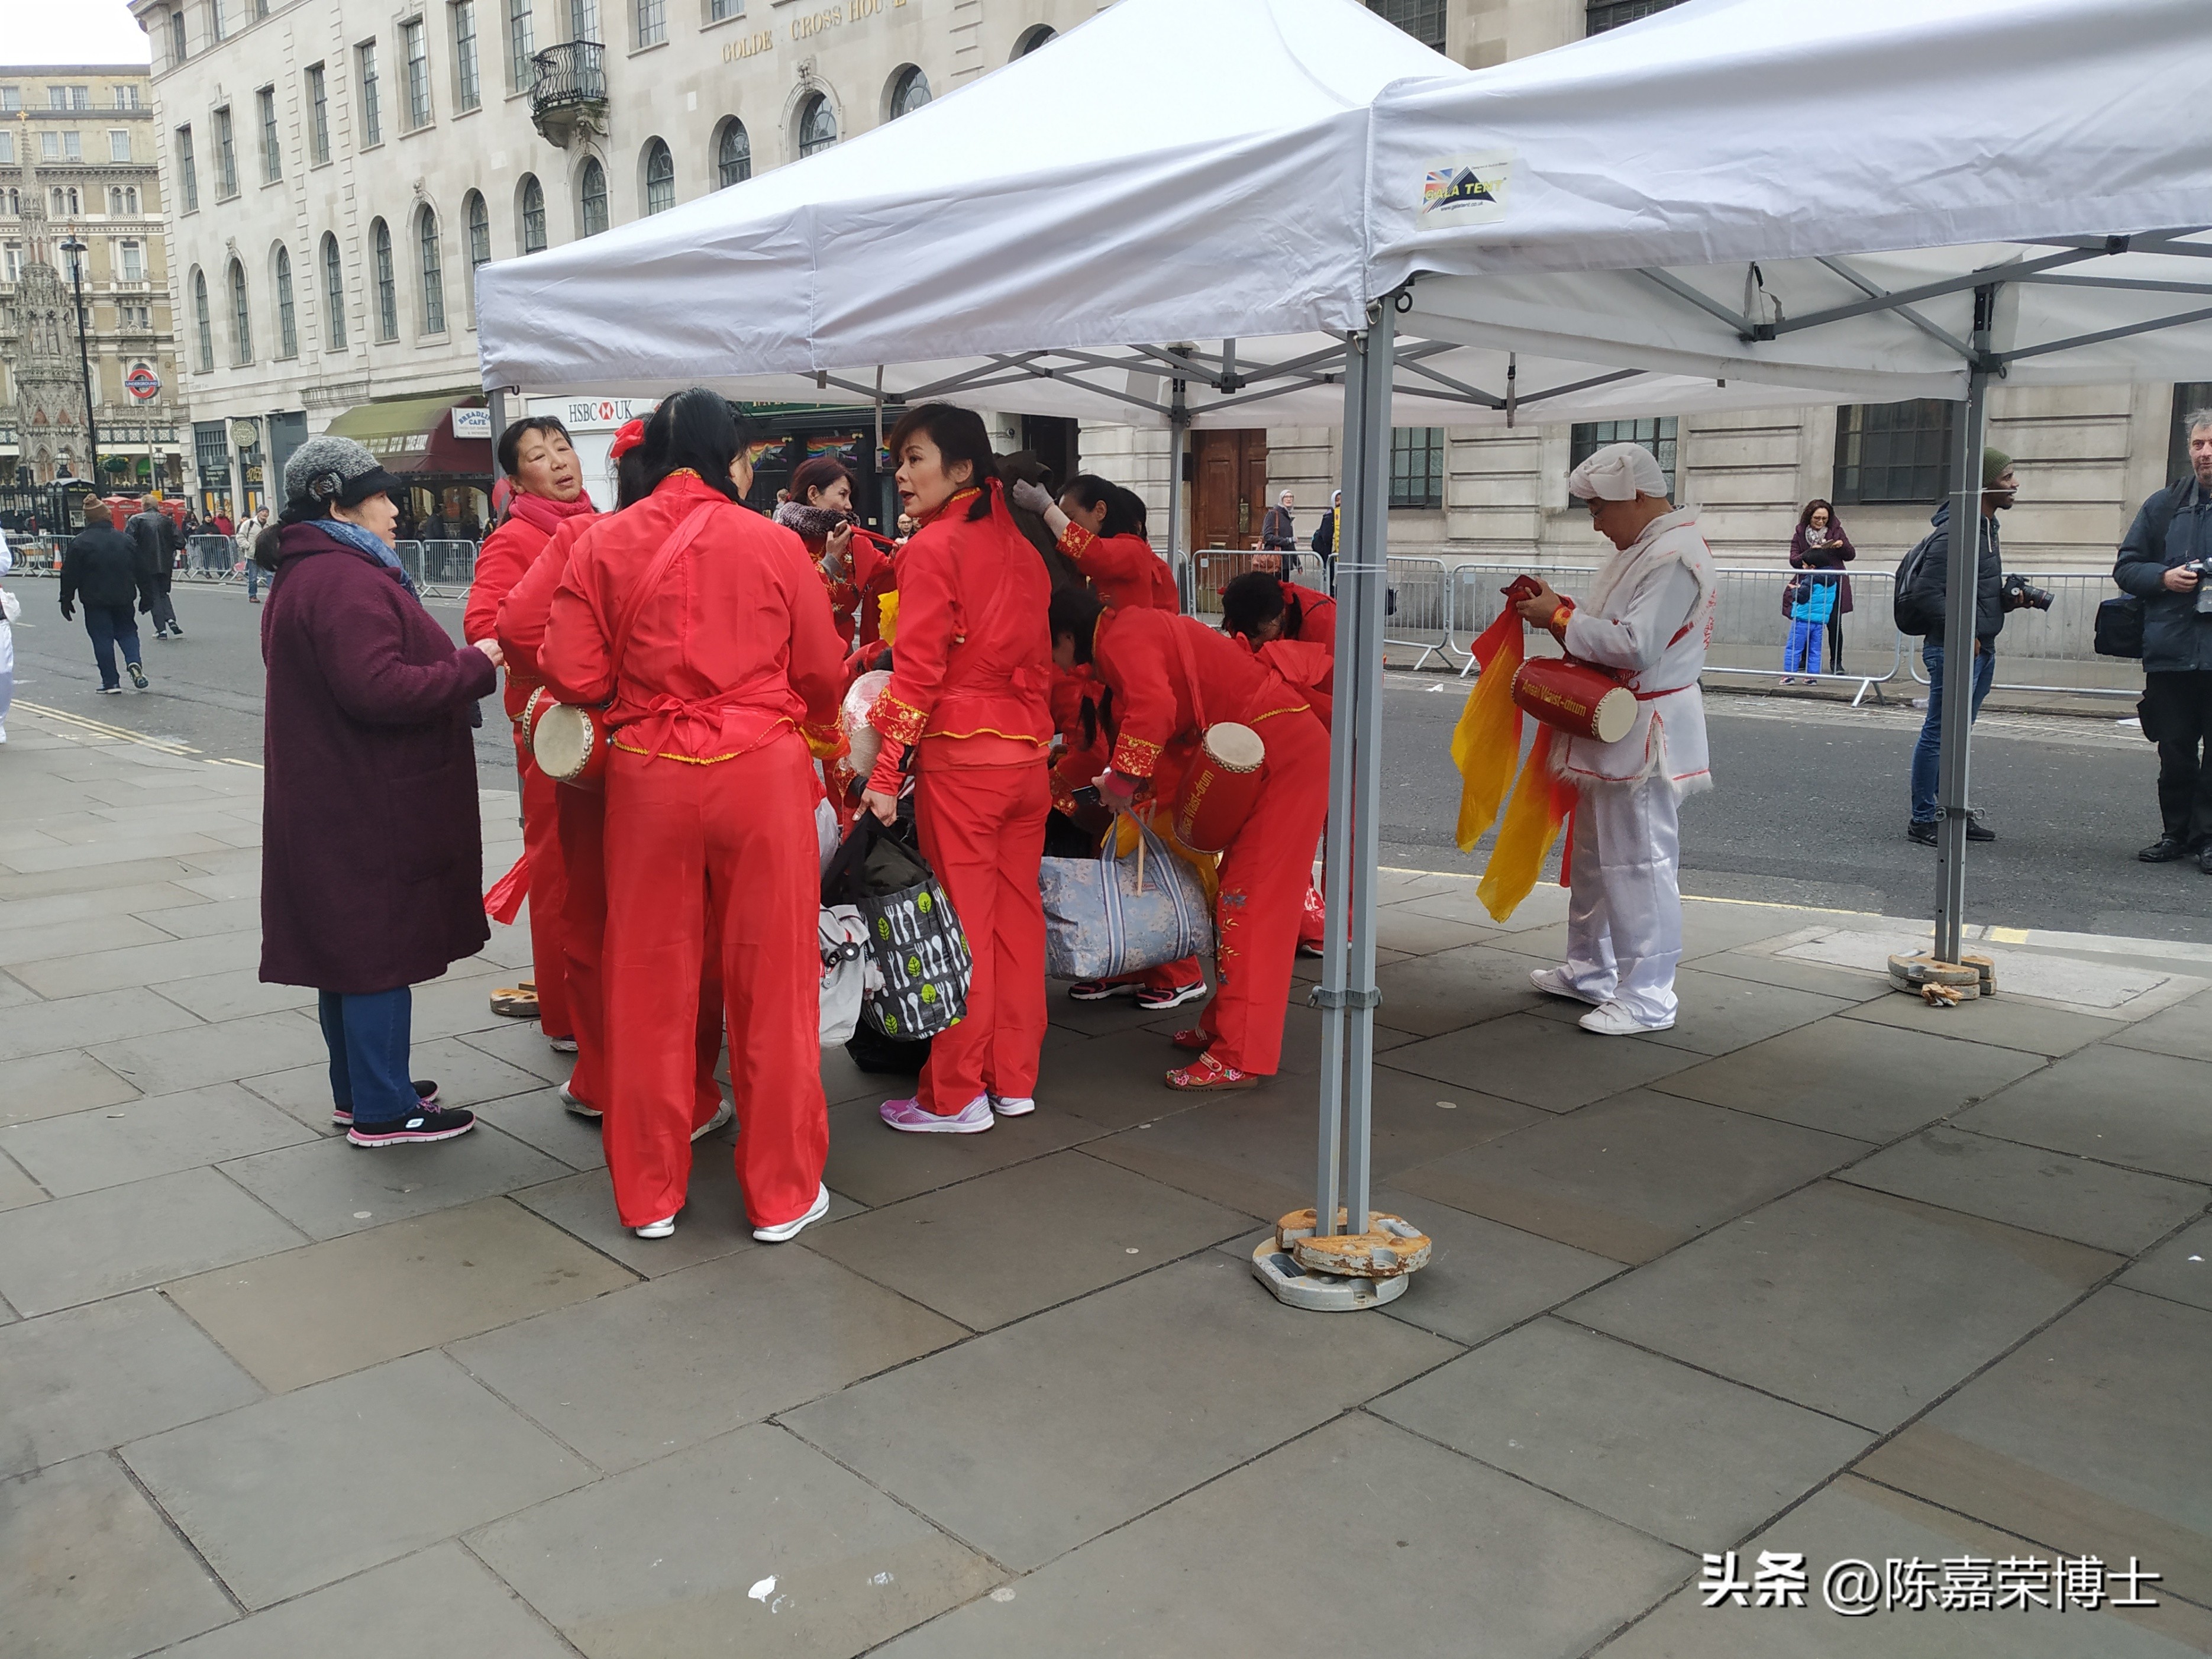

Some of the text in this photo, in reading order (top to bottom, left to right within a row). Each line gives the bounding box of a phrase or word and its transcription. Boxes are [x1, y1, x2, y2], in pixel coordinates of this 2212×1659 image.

[721, 30, 773, 63] GOLDE
[790, 5, 842, 40] CROSS
[1425, 180, 1503, 200] GALA TENT
[569, 400, 633, 423] HSBC UK
[1183, 770, 1215, 818] Waist-drum
